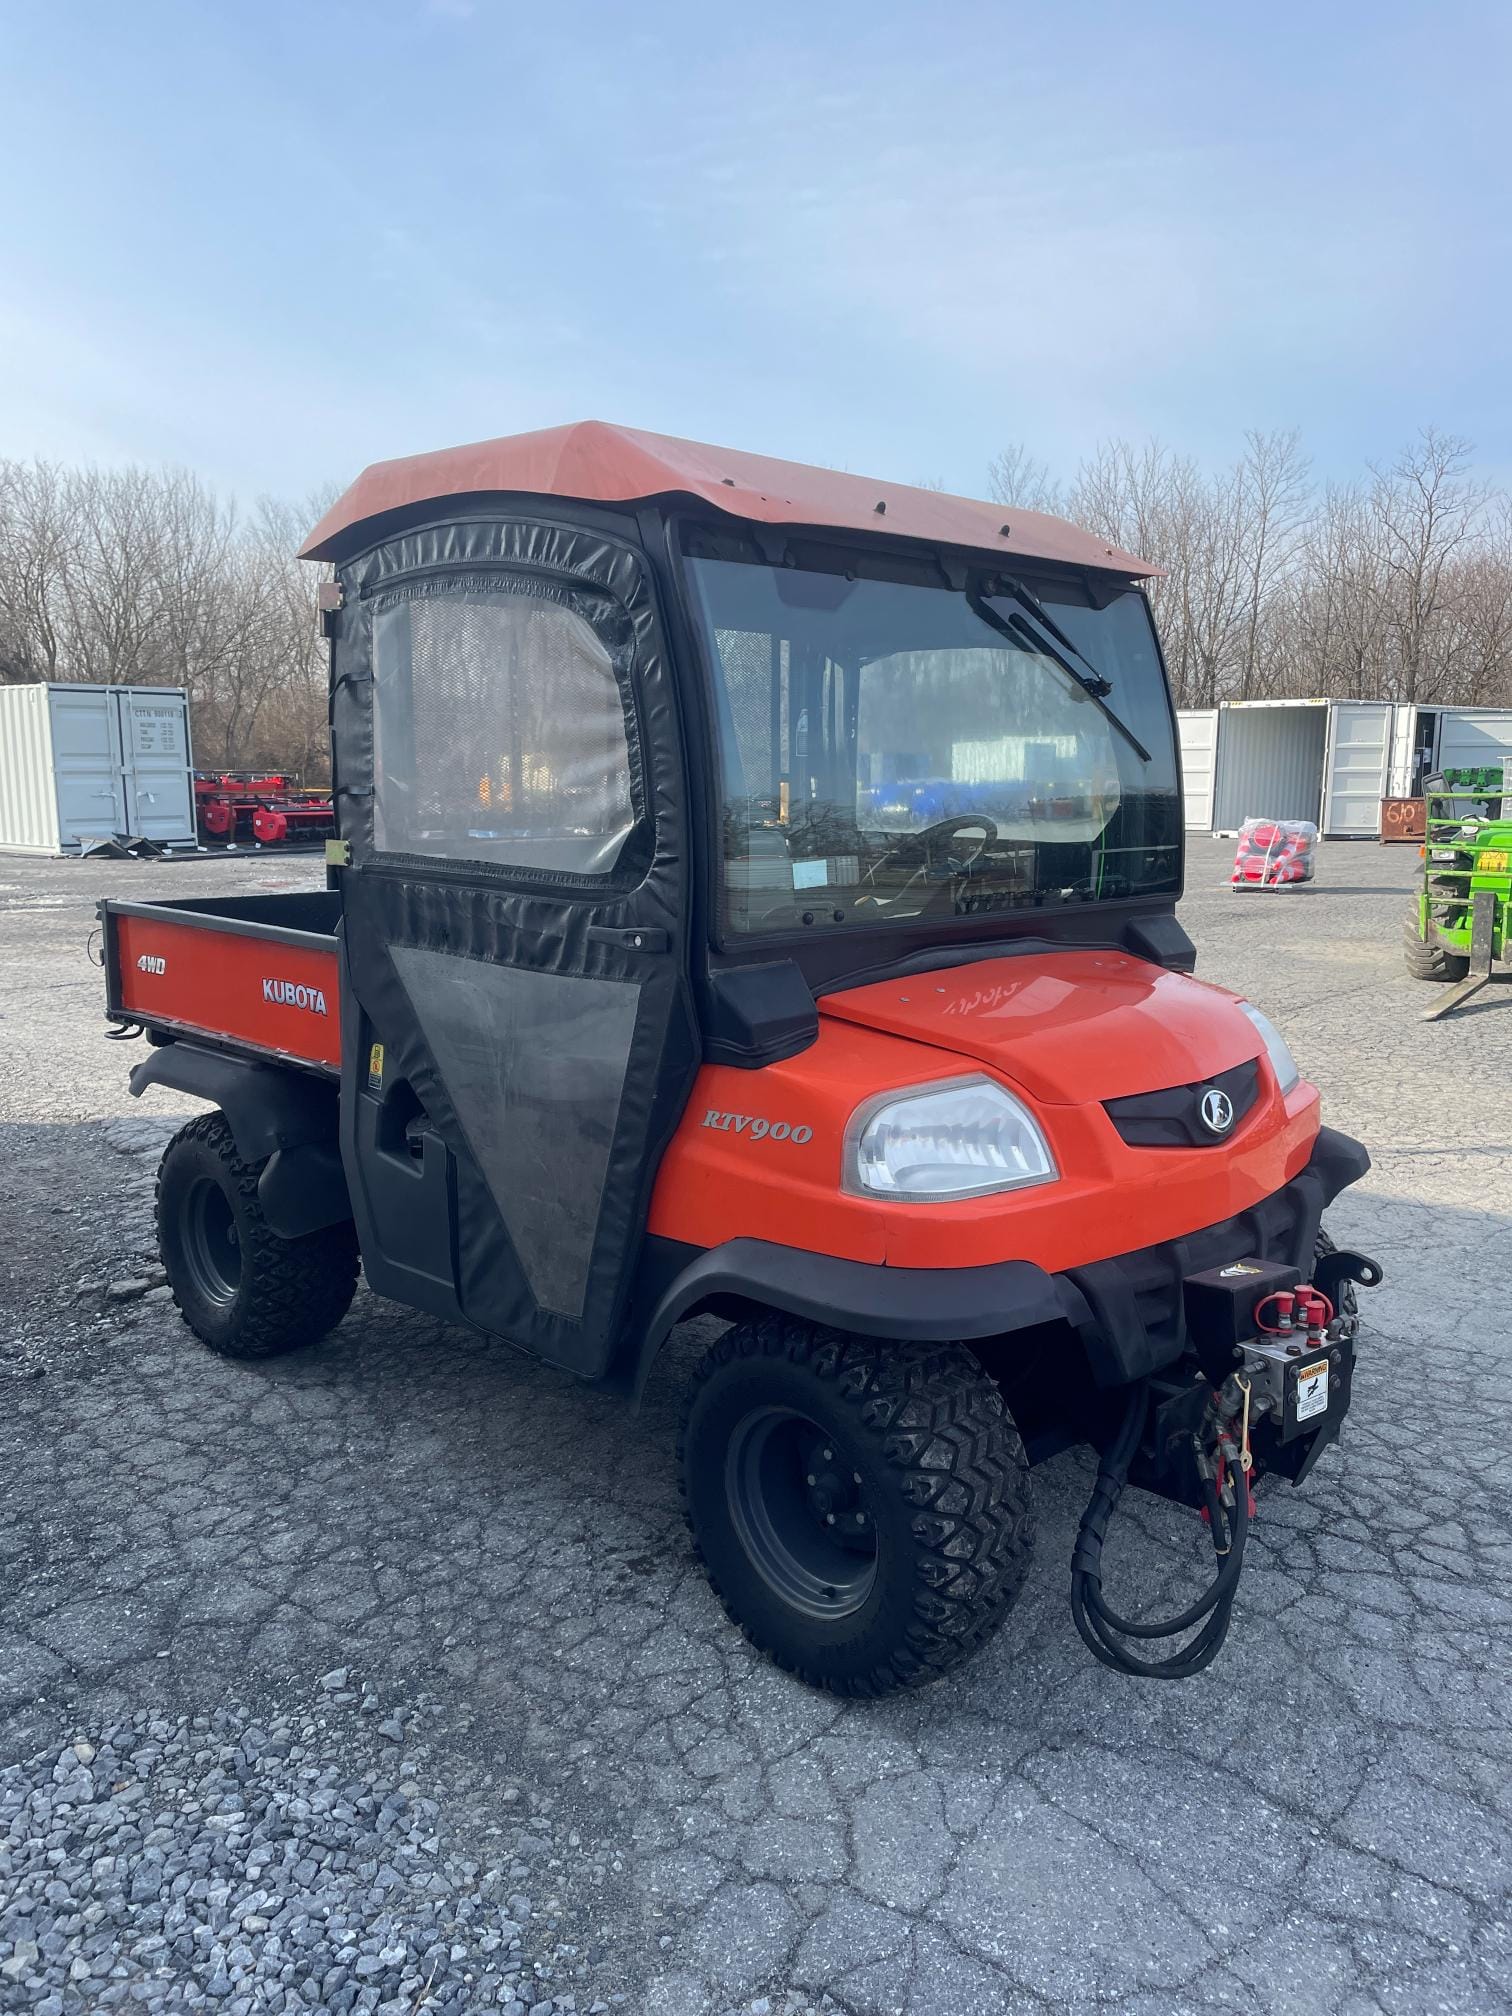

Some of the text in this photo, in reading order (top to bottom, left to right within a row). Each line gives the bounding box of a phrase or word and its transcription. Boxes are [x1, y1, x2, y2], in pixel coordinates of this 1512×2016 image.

[136, 954, 166, 976] 4WD
[262, 977, 327, 1016] KUBOTA
[702, 1109, 814, 1145] RTV900
